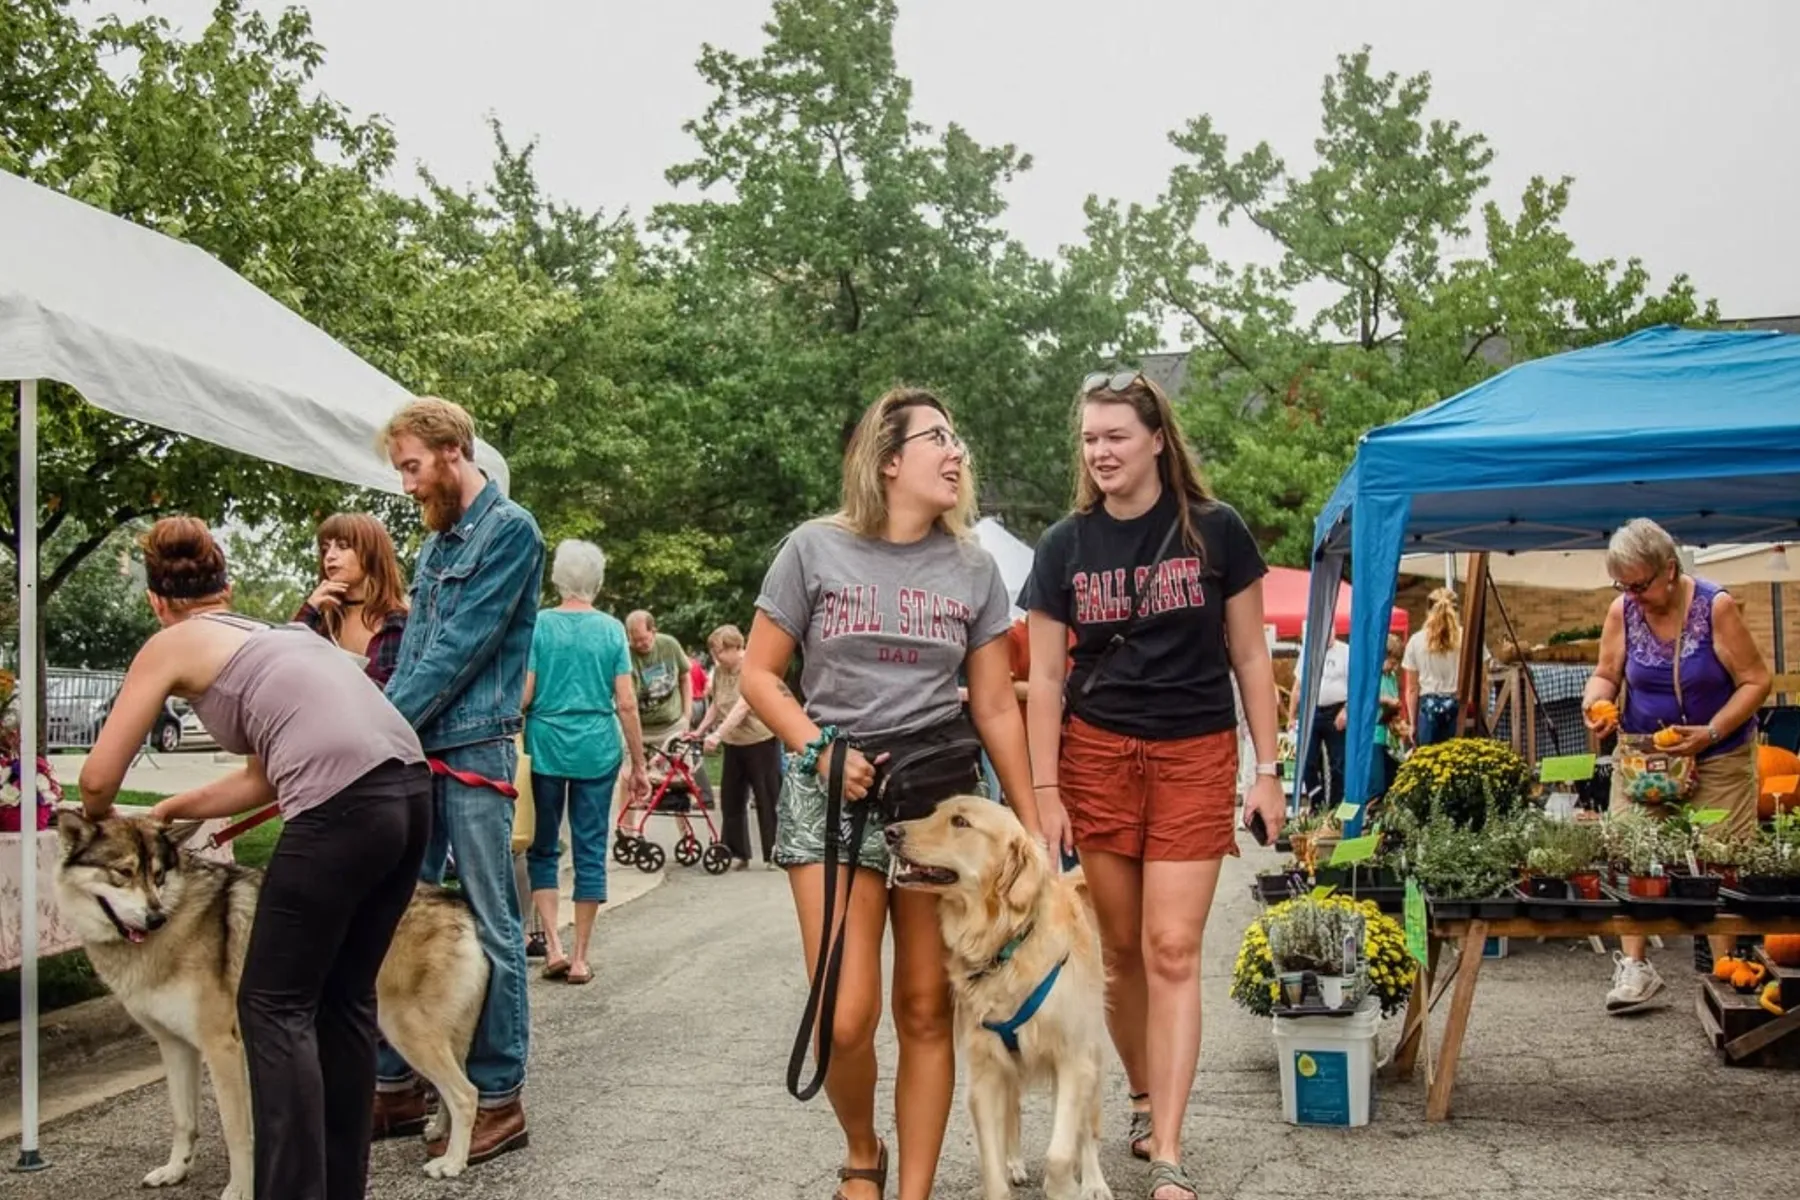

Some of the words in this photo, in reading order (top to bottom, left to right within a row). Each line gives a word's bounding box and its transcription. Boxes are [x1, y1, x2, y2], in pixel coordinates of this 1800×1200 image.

[822, 584, 883, 641] BALL
[1072, 568, 1131, 624] BALL
[877, 647, 919, 664] DAD
